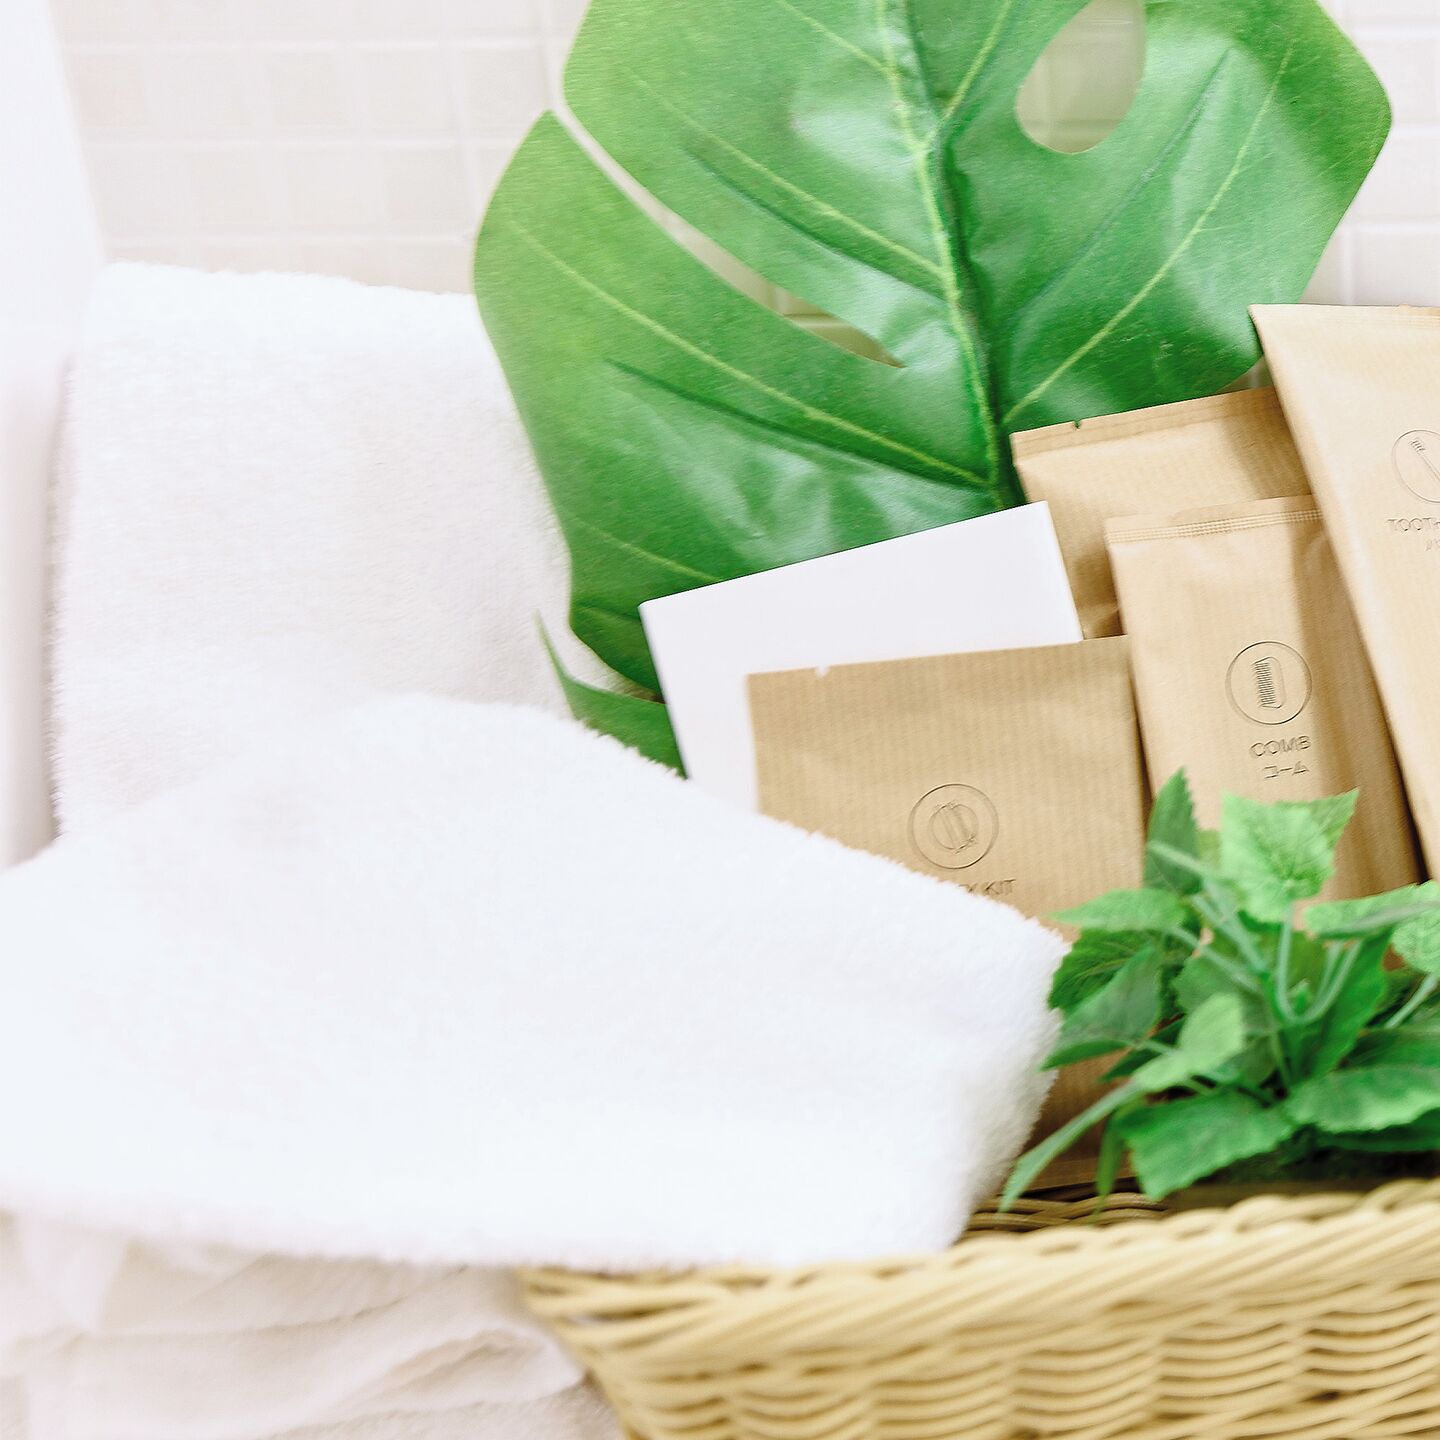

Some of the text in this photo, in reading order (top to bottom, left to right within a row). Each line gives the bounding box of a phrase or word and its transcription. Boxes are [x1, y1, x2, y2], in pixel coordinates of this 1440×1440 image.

[1249, 735, 1312, 758] COMB
[1263, 760, 1310, 779] コーム
[983, 878, 1016, 896] KIT
